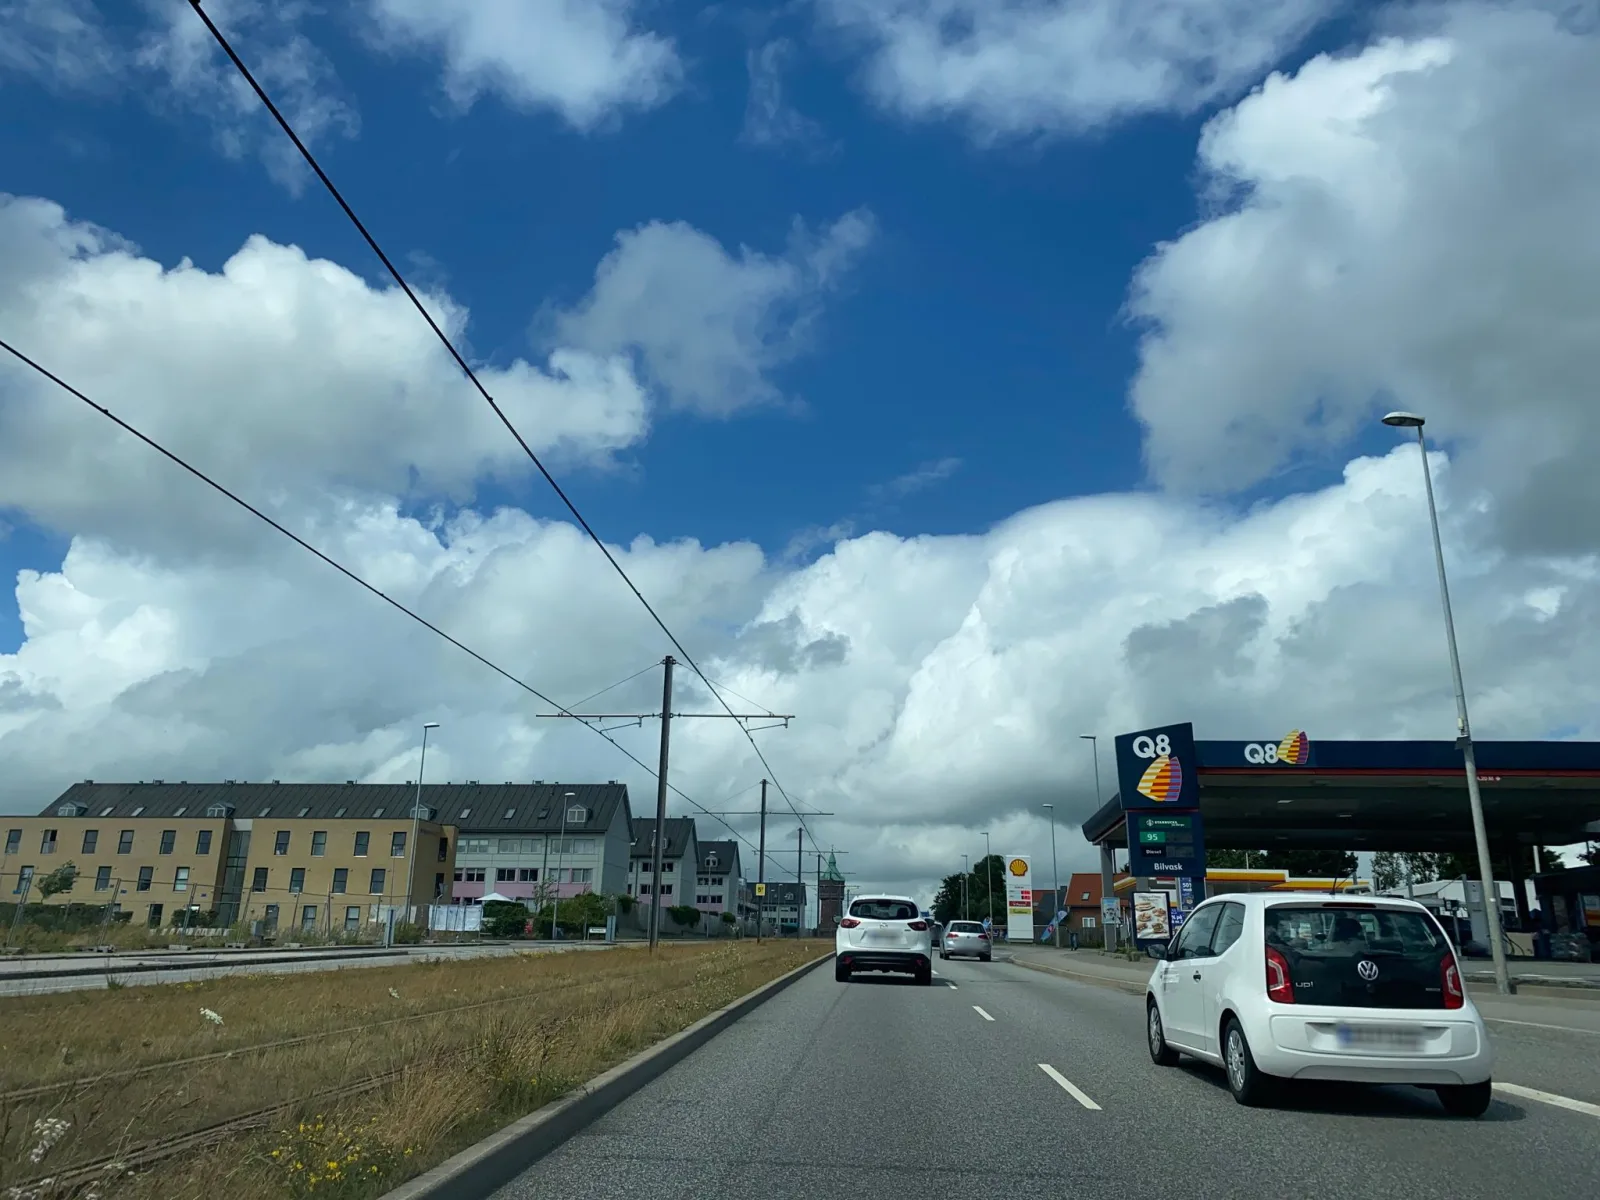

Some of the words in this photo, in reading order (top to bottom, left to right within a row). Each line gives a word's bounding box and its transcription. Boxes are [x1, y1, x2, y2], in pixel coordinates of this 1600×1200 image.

[1132, 733, 1171, 758] Q8
[1244, 743, 1279, 764] Q8
[1147, 833, 1158, 841] 95
[1154, 862, 1183, 871] Bilvask
